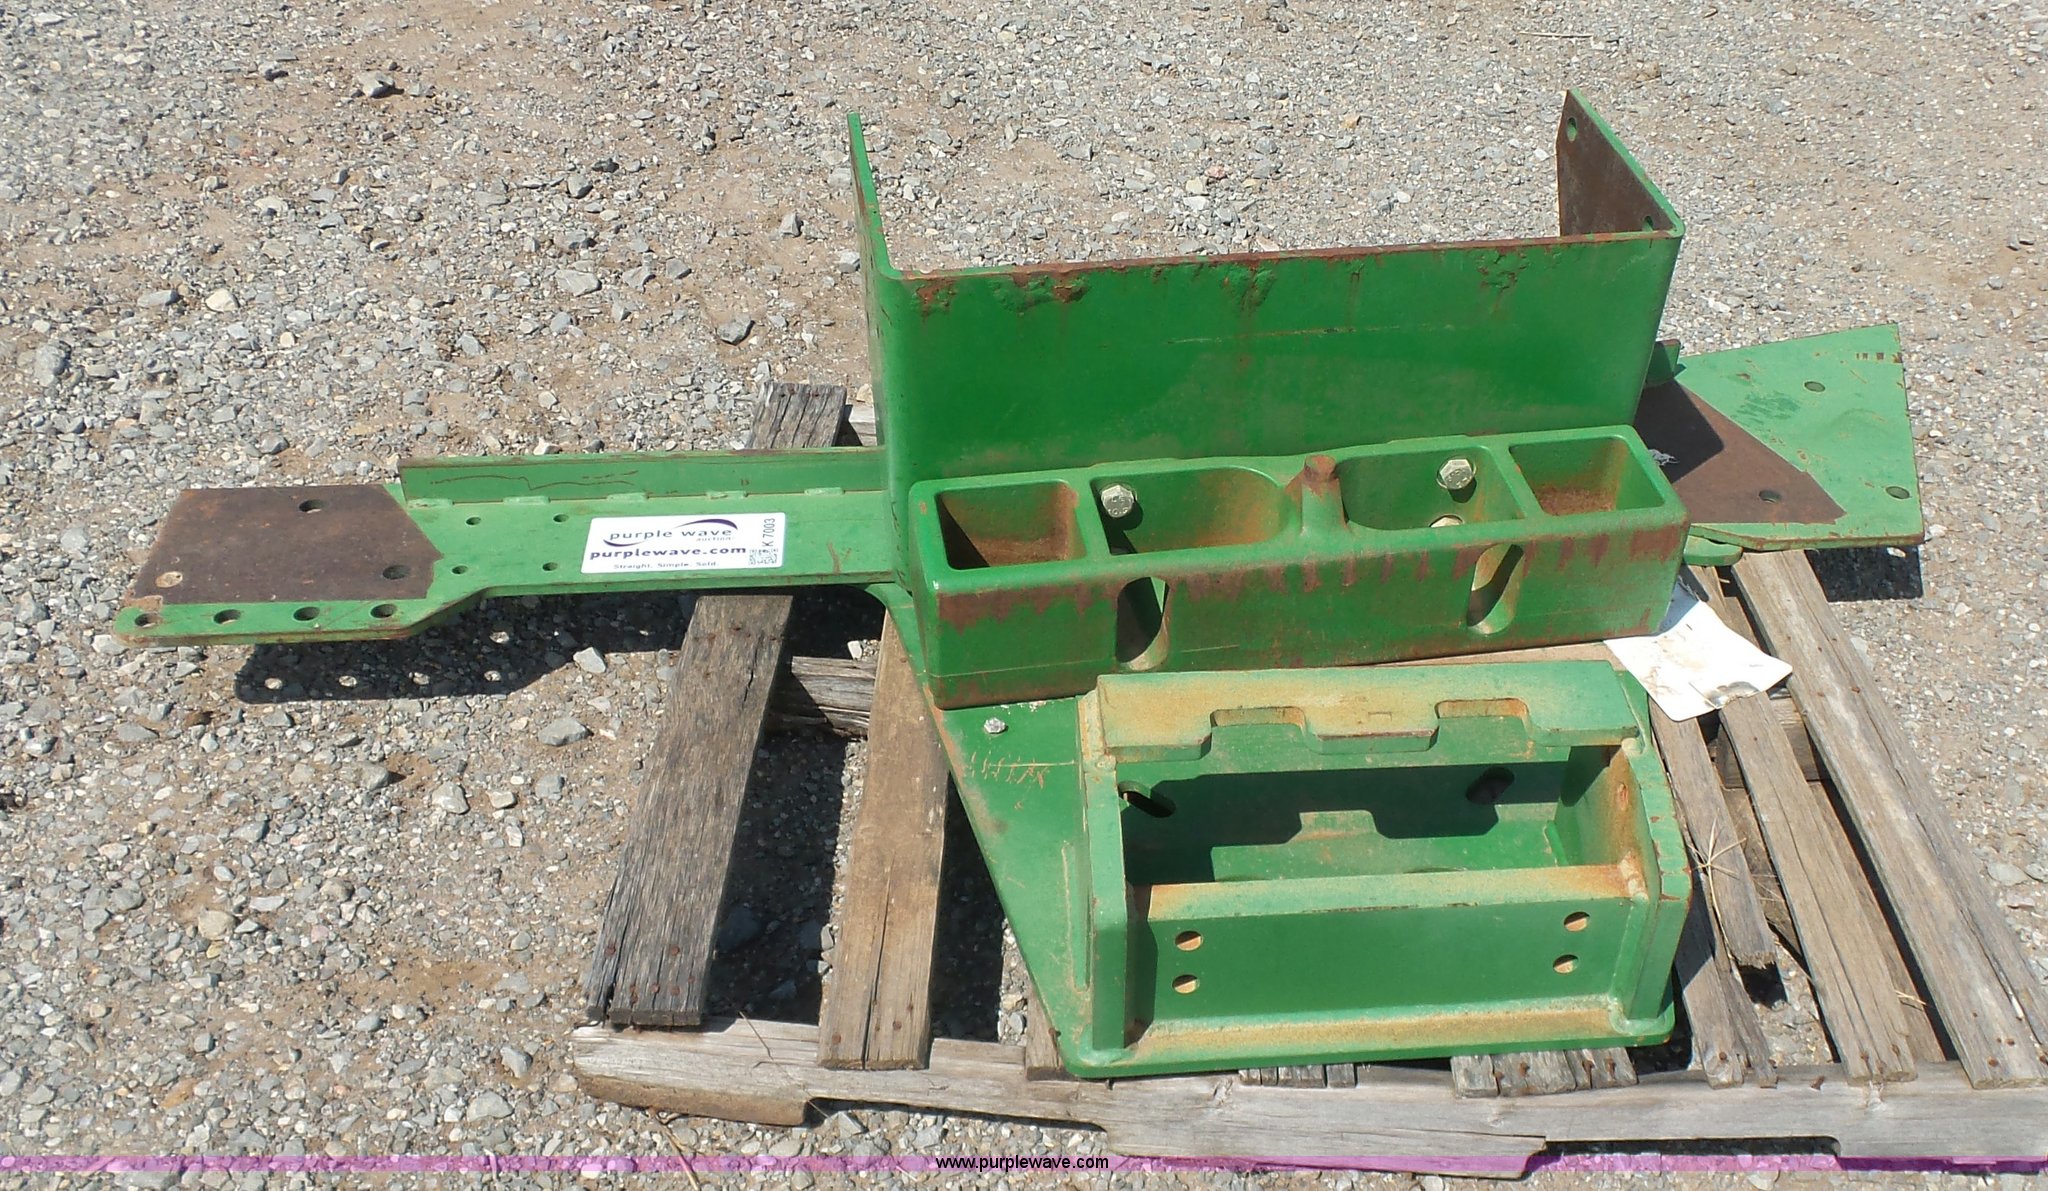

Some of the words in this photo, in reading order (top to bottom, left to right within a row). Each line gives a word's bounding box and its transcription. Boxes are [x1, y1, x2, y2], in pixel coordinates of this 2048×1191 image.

[610, 529, 673, 541] purple
[681, 528, 732, 537] wave
[762, 518, 776, 538] 7003
[590, 546, 747, 561] purplewave.com
